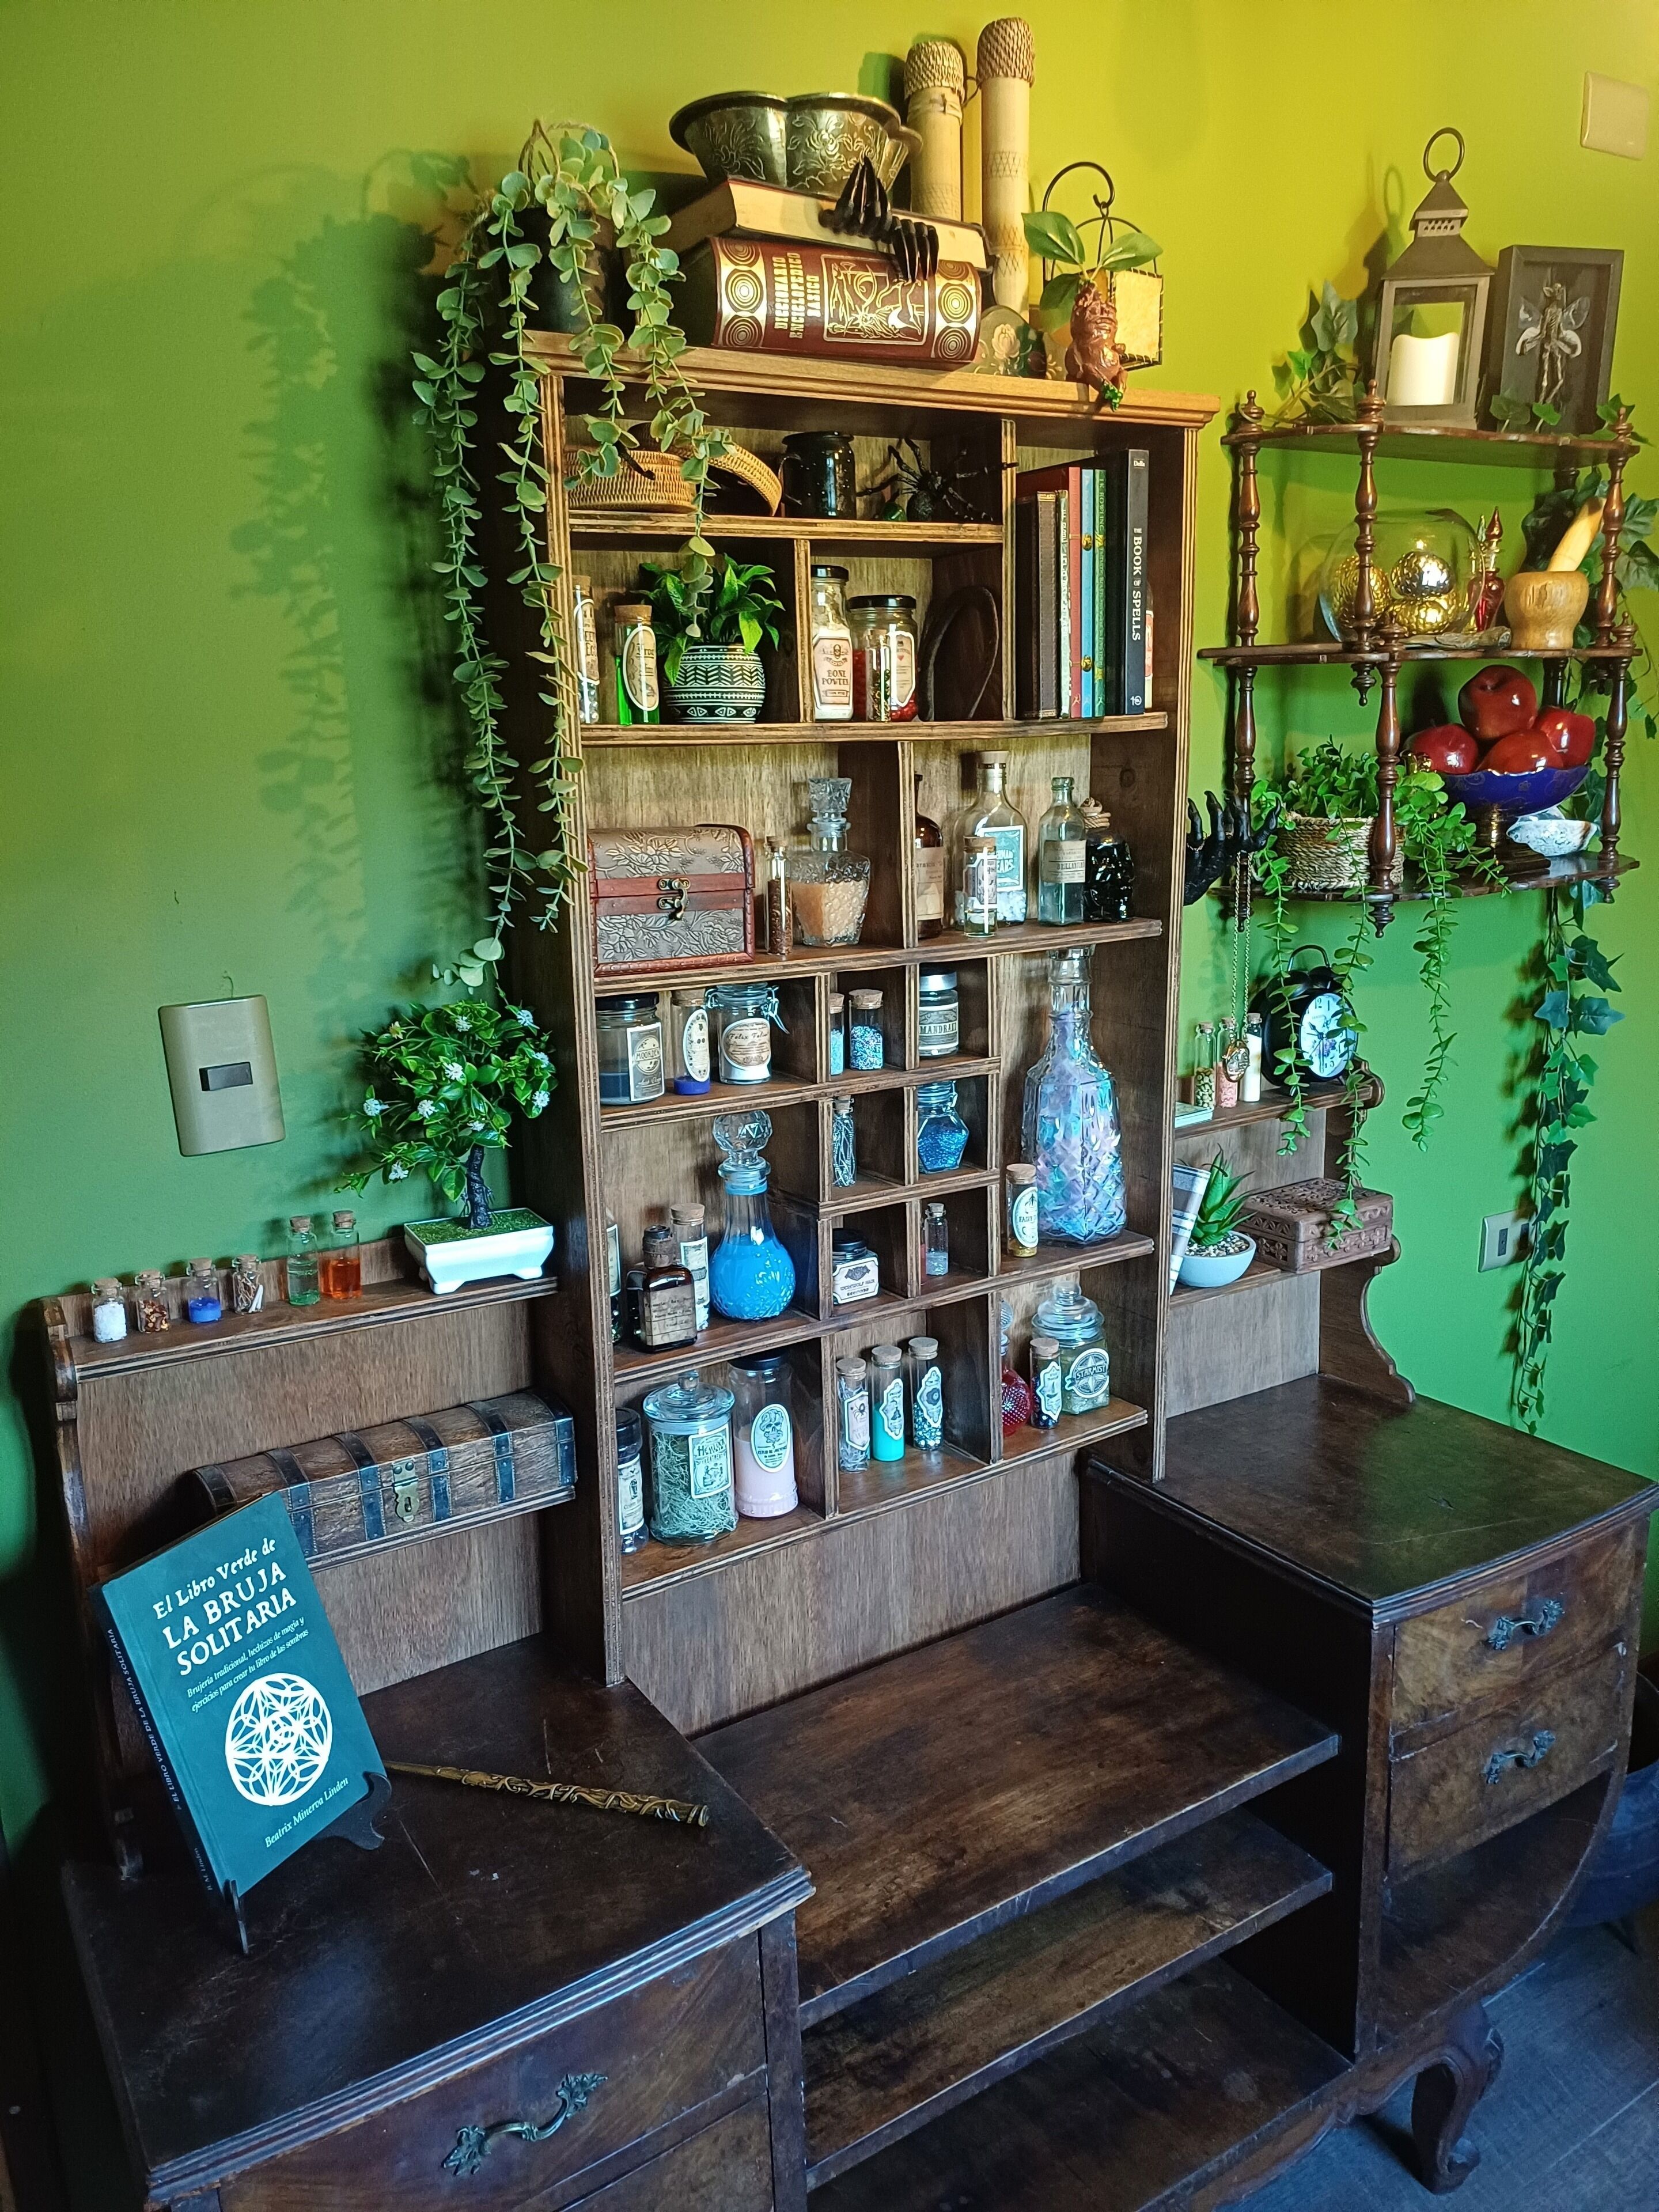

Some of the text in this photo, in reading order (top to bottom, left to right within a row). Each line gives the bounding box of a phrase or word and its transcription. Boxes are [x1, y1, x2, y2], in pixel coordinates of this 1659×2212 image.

[772, 256, 789, 329] DICCIONARIO
[787, 252, 805, 339] ENCICLOPEDICO
[806, 274, 821, 317] BASICO
[1133, 536, 1143, 575] BOOK
[1132, 590, 1142, 641] SPELLS
[997, 859, 1014, 873] EARS
[1315, 998, 1322, 1009] 12
[1076, 1365, 1106, 1380] STARMIST
[153, 1537, 276, 1620] El Libro Verde de
[162, 1562, 287, 1649] LA BRUJA
[107, 1628, 130, 1675] SOLITARIA
[177, 1588, 297, 1676] SOLITARIA
[187, 1616, 304, 1698] Brujería tradicional, hechizos de magia y
[191, 1629, 309, 1714] ejercicios para crear tu libro de las sombras
[126, 1676, 142, 1706] BRUJA
[138, 1707, 146, 1719] LA
[148, 1734, 164, 1763] VERDE
[161, 1764, 175, 1790] LIBRO
[264, 1777, 349, 1849] Beatrix Minerva Linden
